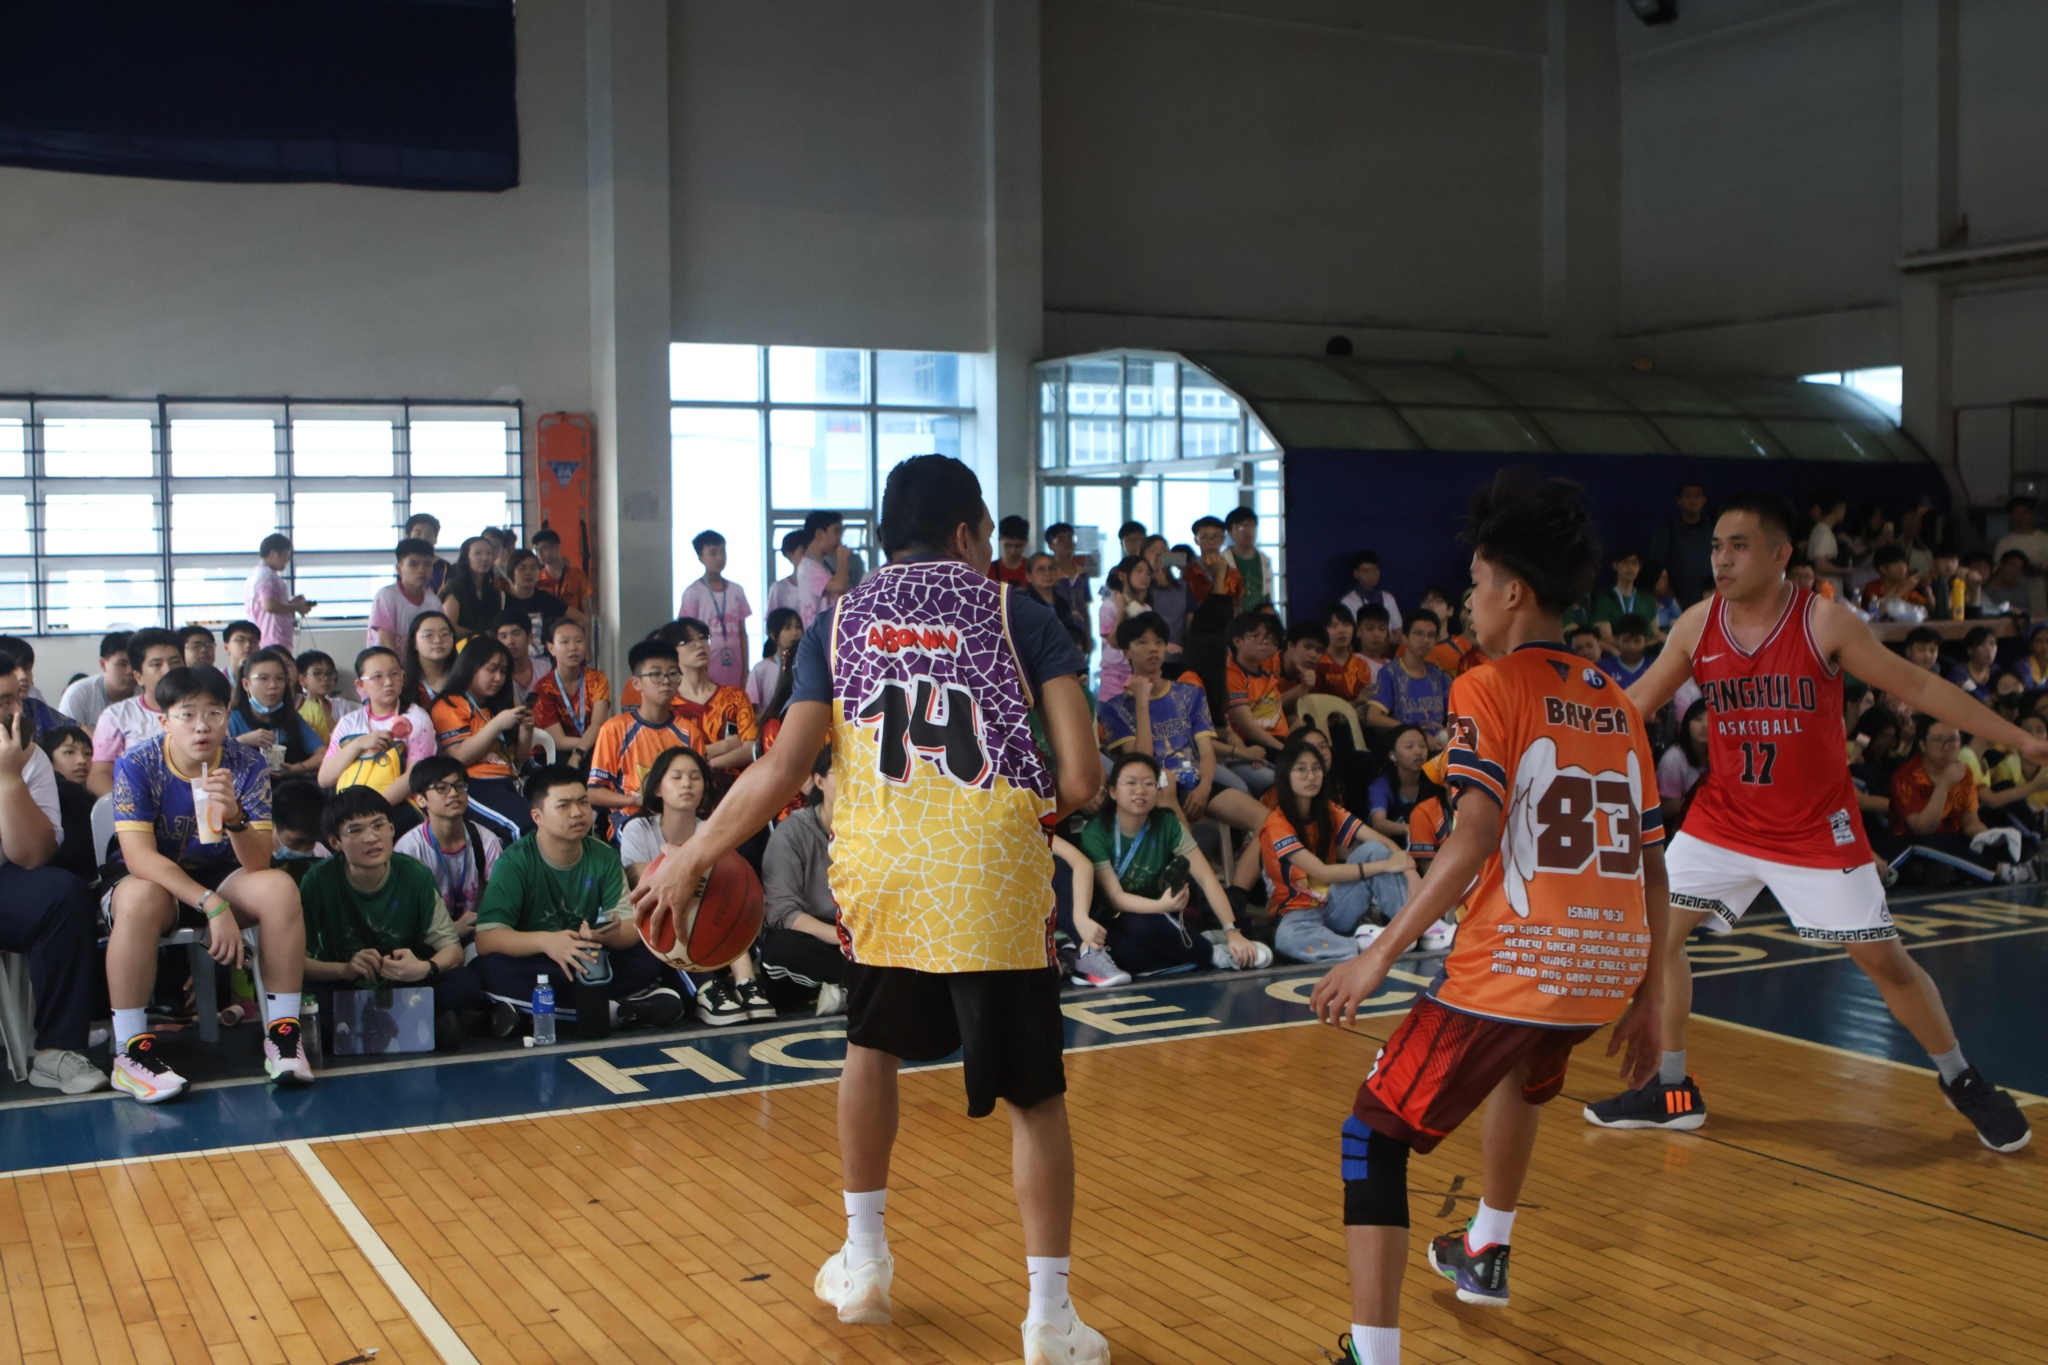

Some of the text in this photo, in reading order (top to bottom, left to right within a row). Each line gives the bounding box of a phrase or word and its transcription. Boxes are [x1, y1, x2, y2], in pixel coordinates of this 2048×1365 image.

[857, 675, 993, 788] 14
[1544, 696, 1630, 736] BAYSA
[1740, 741, 1778, 786] 17
[1533, 774, 1643, 881] 83
